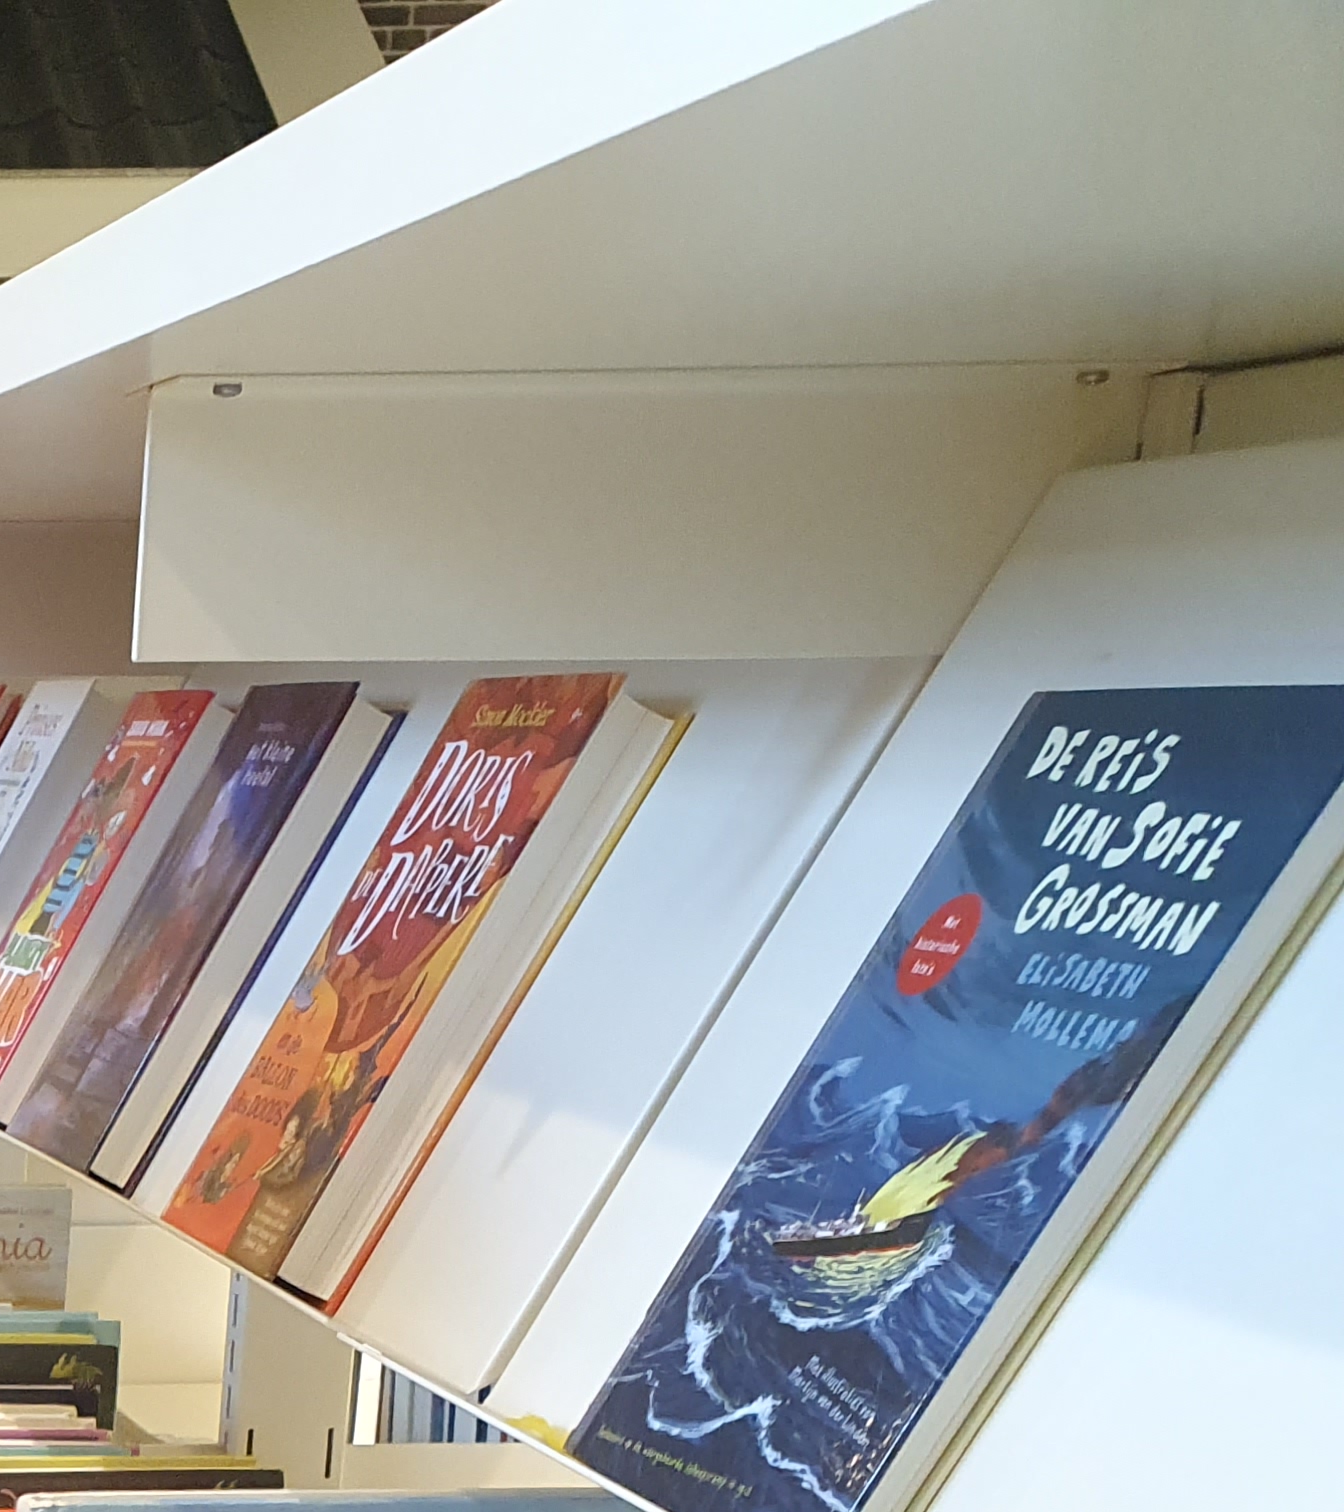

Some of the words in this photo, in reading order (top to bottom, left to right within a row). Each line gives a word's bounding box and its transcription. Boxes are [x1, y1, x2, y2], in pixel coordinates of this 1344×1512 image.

[390, 739, 536, 846] DORIS
[1026, 725, 1092, 782] DE
[1041, 803, 1122, 862] VAN
[337, 833, 515, 957] DAPPERE
[1014, 863, 1221, 956] GROSSMAN
